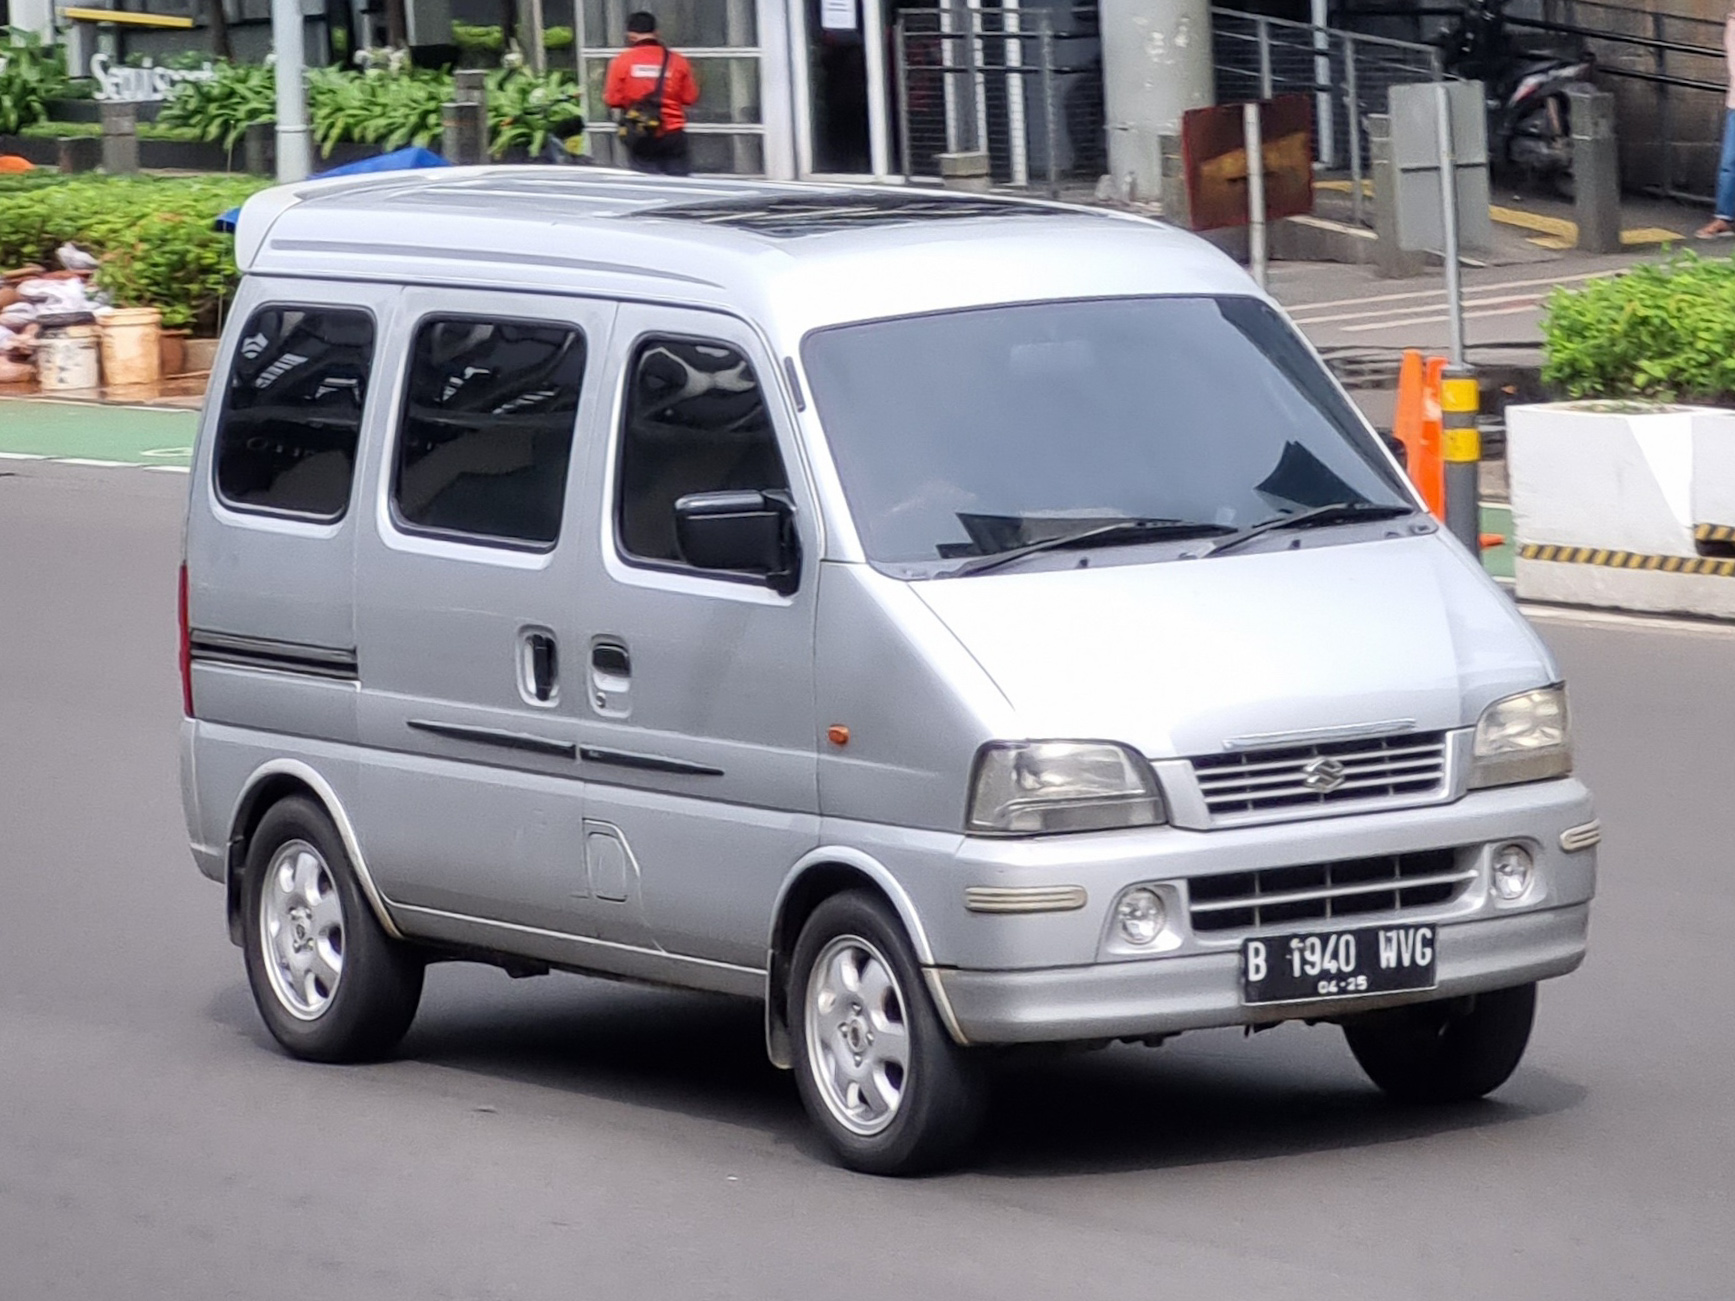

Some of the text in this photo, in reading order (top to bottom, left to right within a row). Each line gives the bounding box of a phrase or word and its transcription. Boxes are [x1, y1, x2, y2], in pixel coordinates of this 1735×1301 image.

[1247, 927, 1433, 982] B 1940 WVG
